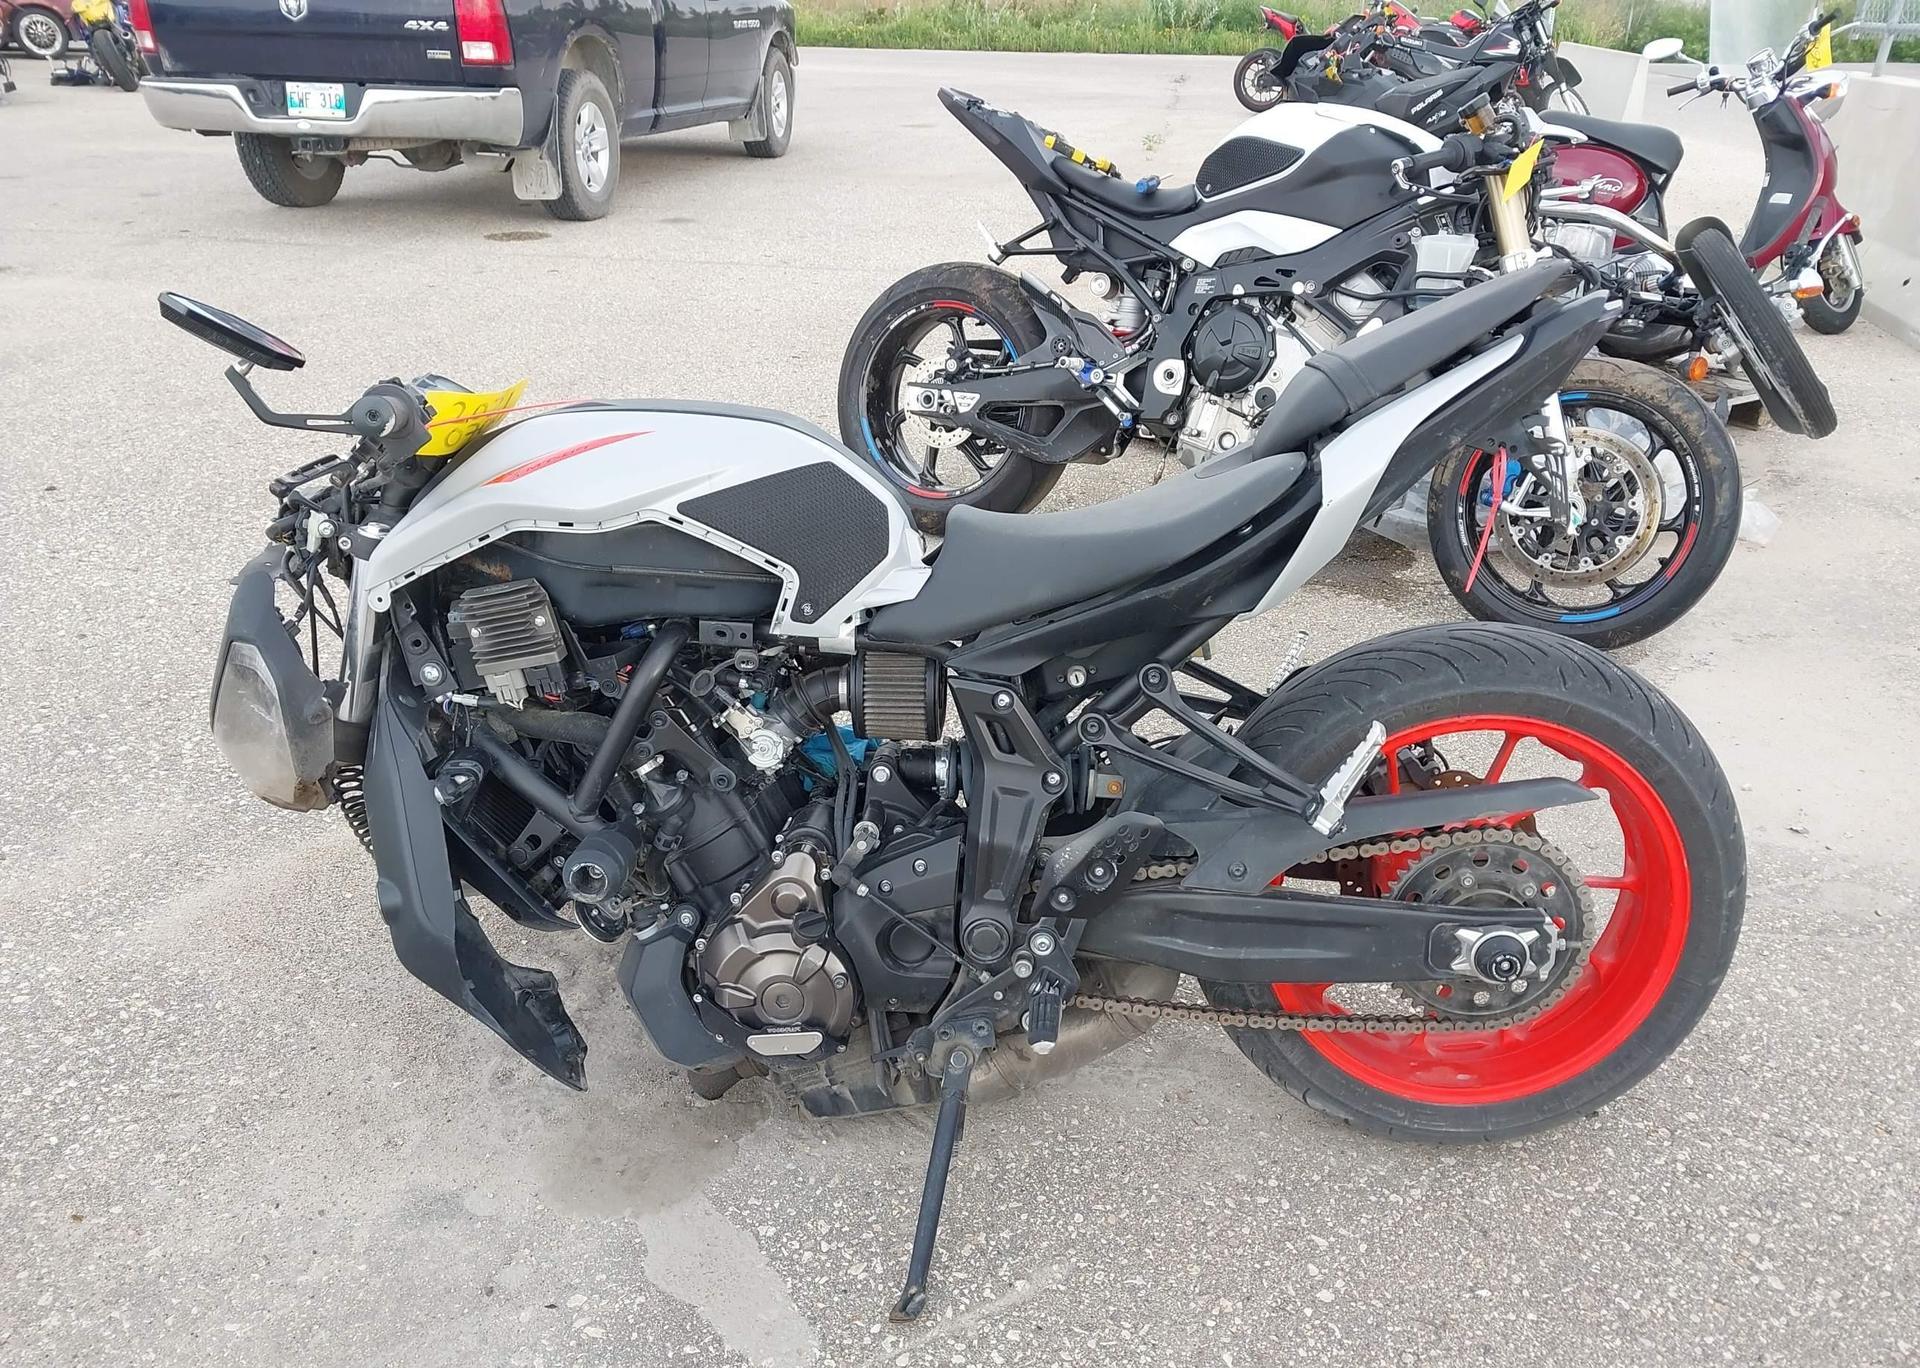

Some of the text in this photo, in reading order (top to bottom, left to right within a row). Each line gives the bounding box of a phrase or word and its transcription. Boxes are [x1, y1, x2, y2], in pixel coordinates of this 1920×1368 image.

[403, 19, 450, 31] 4X4
[289, 91, 342, 110] EWF 318
[1410, 88, 1444, 115] POLARIS
